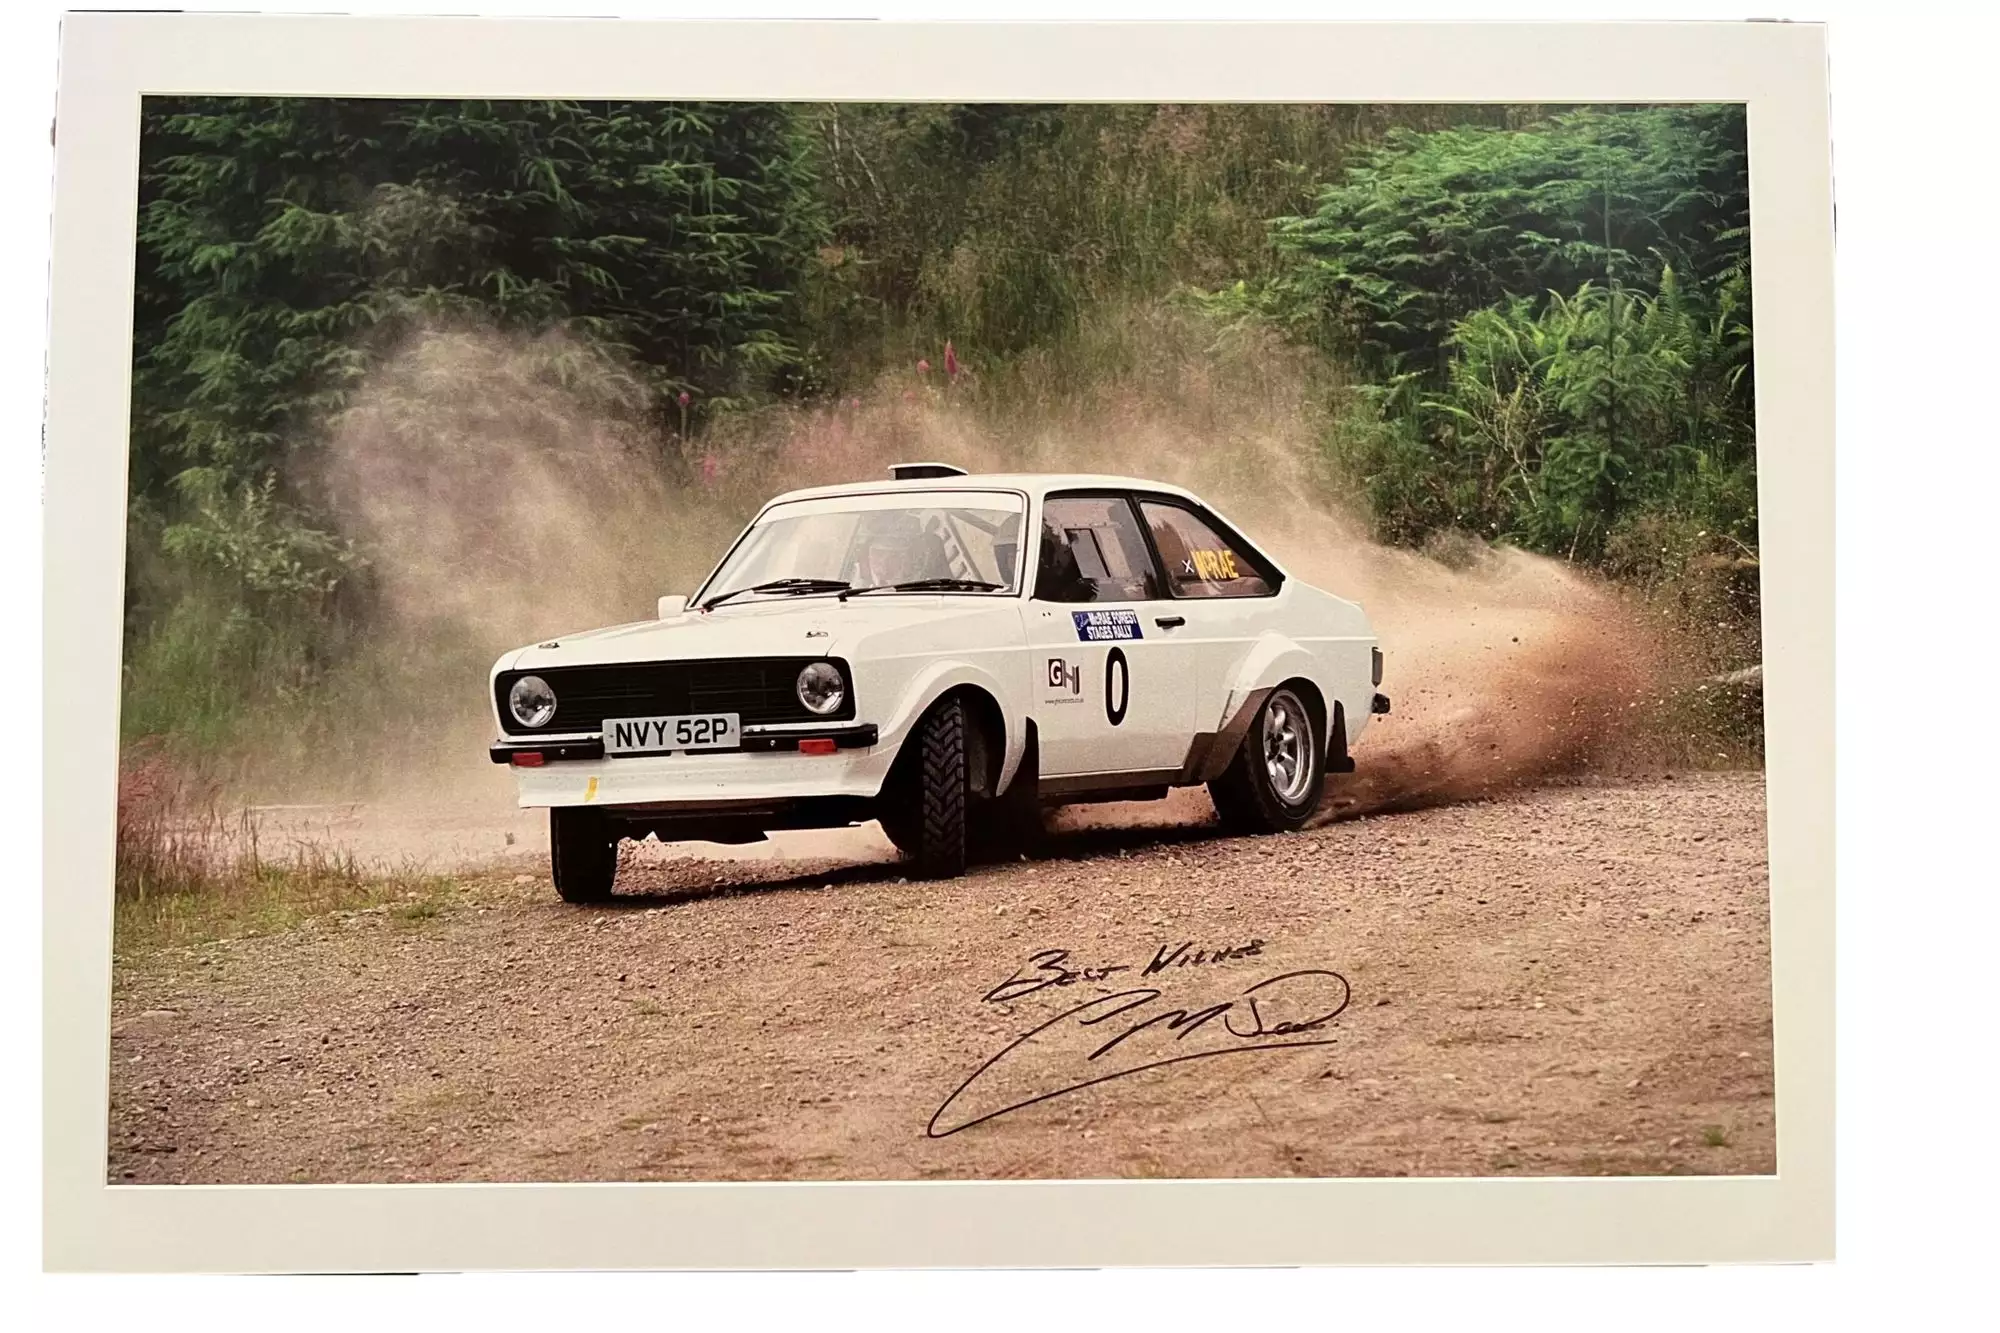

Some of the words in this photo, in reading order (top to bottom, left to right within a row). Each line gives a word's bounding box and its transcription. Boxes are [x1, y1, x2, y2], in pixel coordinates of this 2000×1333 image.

[1111, 611, 1137, 624] FOREST
[1087, 625, 1114, 640] STAGES
[1112, 624, 1133, 639] RALLY
[1105, 646, 1129, 726] 0
[614, 721, 668, 748] NVY
[676, 717, 728, 744] 52P
